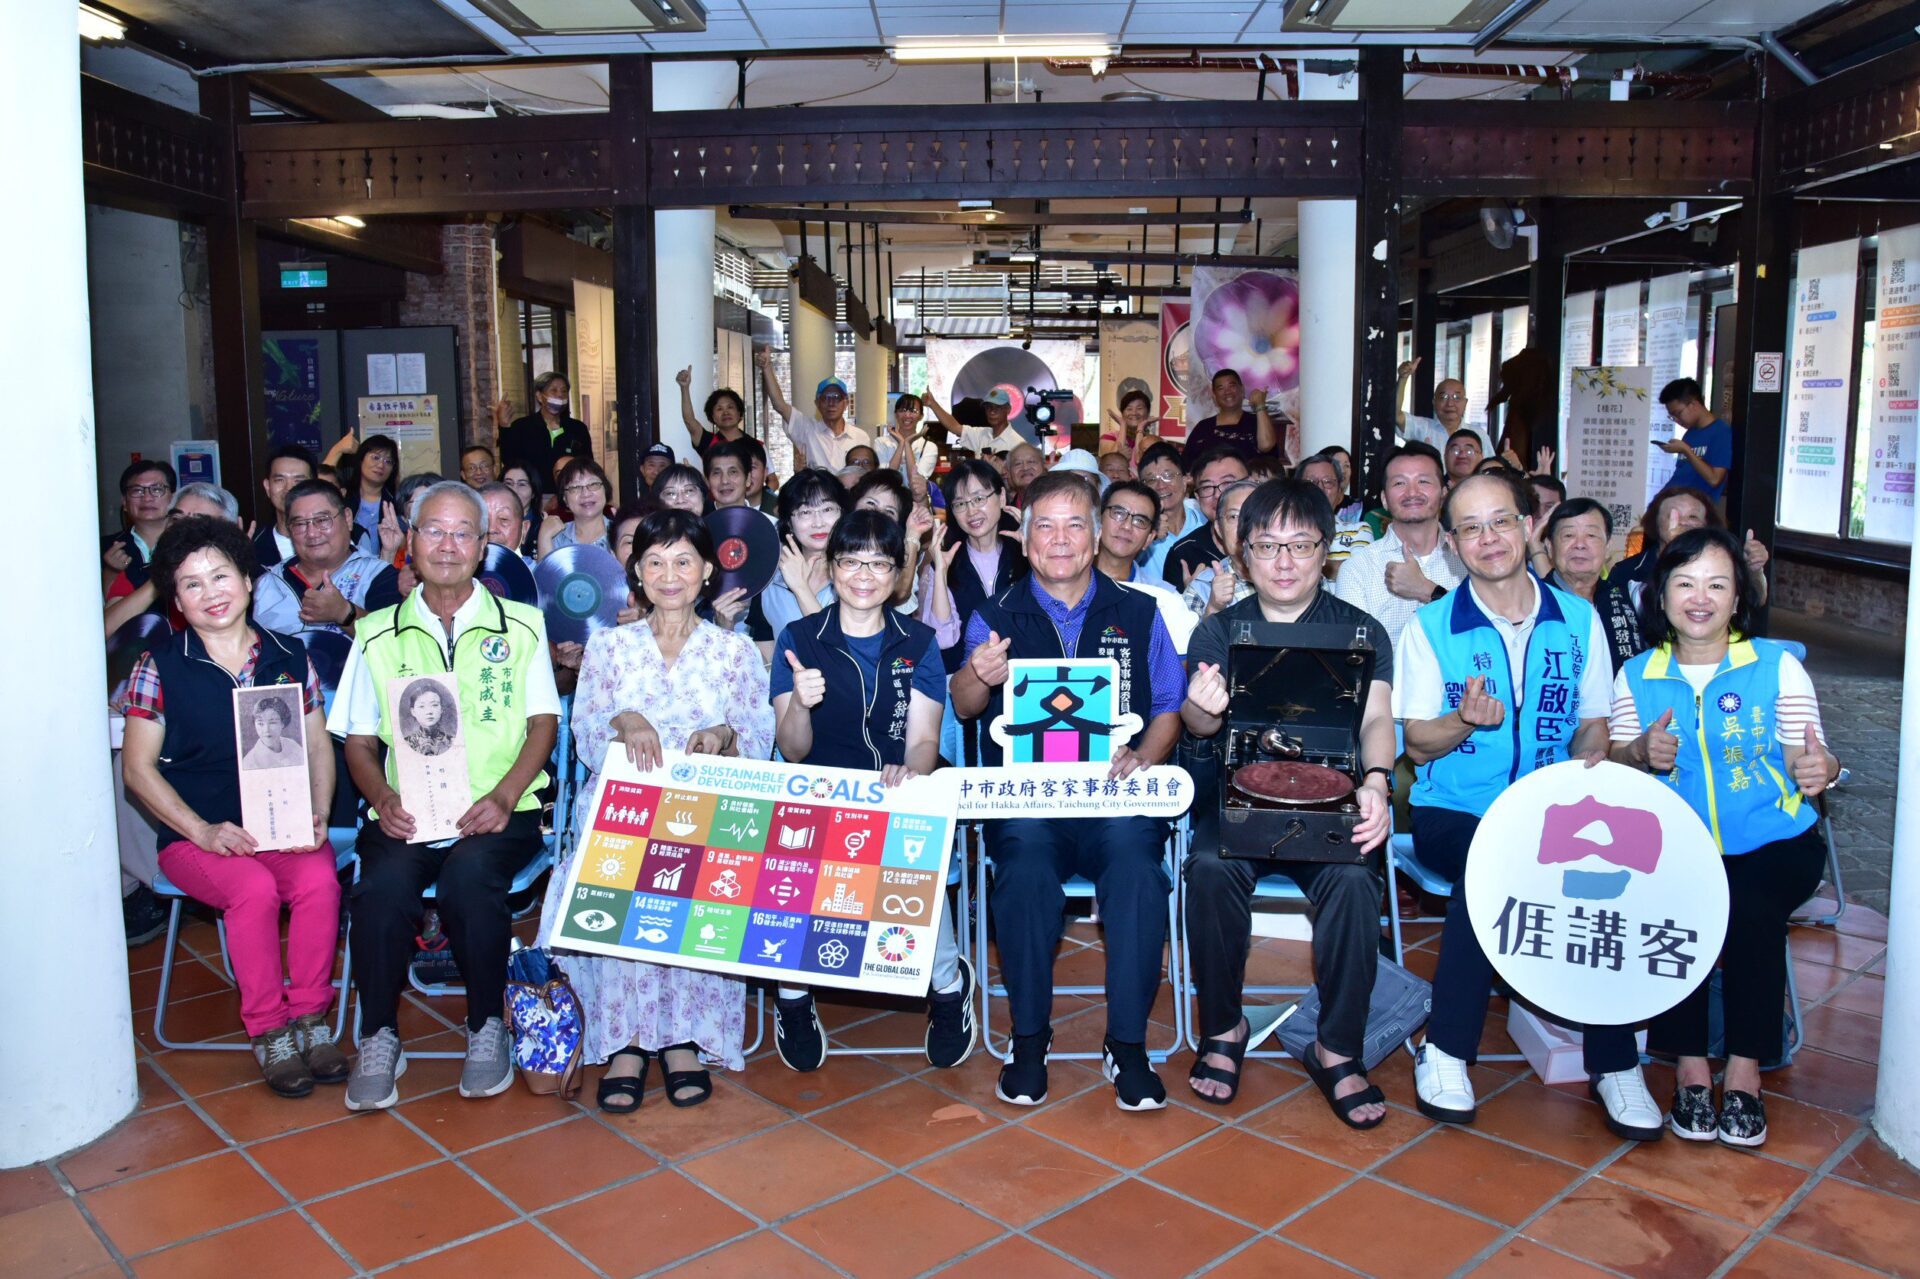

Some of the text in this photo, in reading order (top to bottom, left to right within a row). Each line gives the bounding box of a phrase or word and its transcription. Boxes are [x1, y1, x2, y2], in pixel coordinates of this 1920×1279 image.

[1611, 615, 1634, 657] 劉發現
[1119, 647, 1132, 714] 客家事務委員
[501, 667, 513, 708] 市議員
[479, 666, 497, 723] 蔡成圭
[1535, 648, 1570, 742] 江啟臣
[1720, 715, 1751, 793] 吳振嘉
[700, 765, 786, 783] SUSTAINABLE
[610, 784, 616, 795] 1
[697, 776, 781, 794] DEVELOPMENT
[786, 774, 885, 804] GOALS
[960, 777, 1183, 799] 中市政府客家事務委員會
[664, 791, 672, 804] 2
[720, 799, 728, 811] 3
[975, 801, 989, 809] for
[990, 800, 1020, 809] Hakka
[1023, 800, 1056, 810] Affairs,
[1057, 800, 1101, 811] Taichung
[1102, 800, 1121, 811] City
[1123, 799, 1181, 809] Government
[777, 806, 785, 818] 4
[835, 811, 842, 823] 5
[893, 816, 900, 828] 6
[593, 834, 602, 847] 7
[650, 843, 658, 856] 8
[707, 851, 715, 863] 9
[765, 858, 777, 871] 10
[823, 864, 833, 877] 11
[882, 870, 893, 883] 12
[576, 887, 588, 900] 13
[634, 896, 646, 909] 14
[693, 904, 704, 918] 15
[753, 912, 764, 926] 16
[813, 919, 823, 932] 17
[864, 963, 920, 976] THE GLOBAL GOALS
